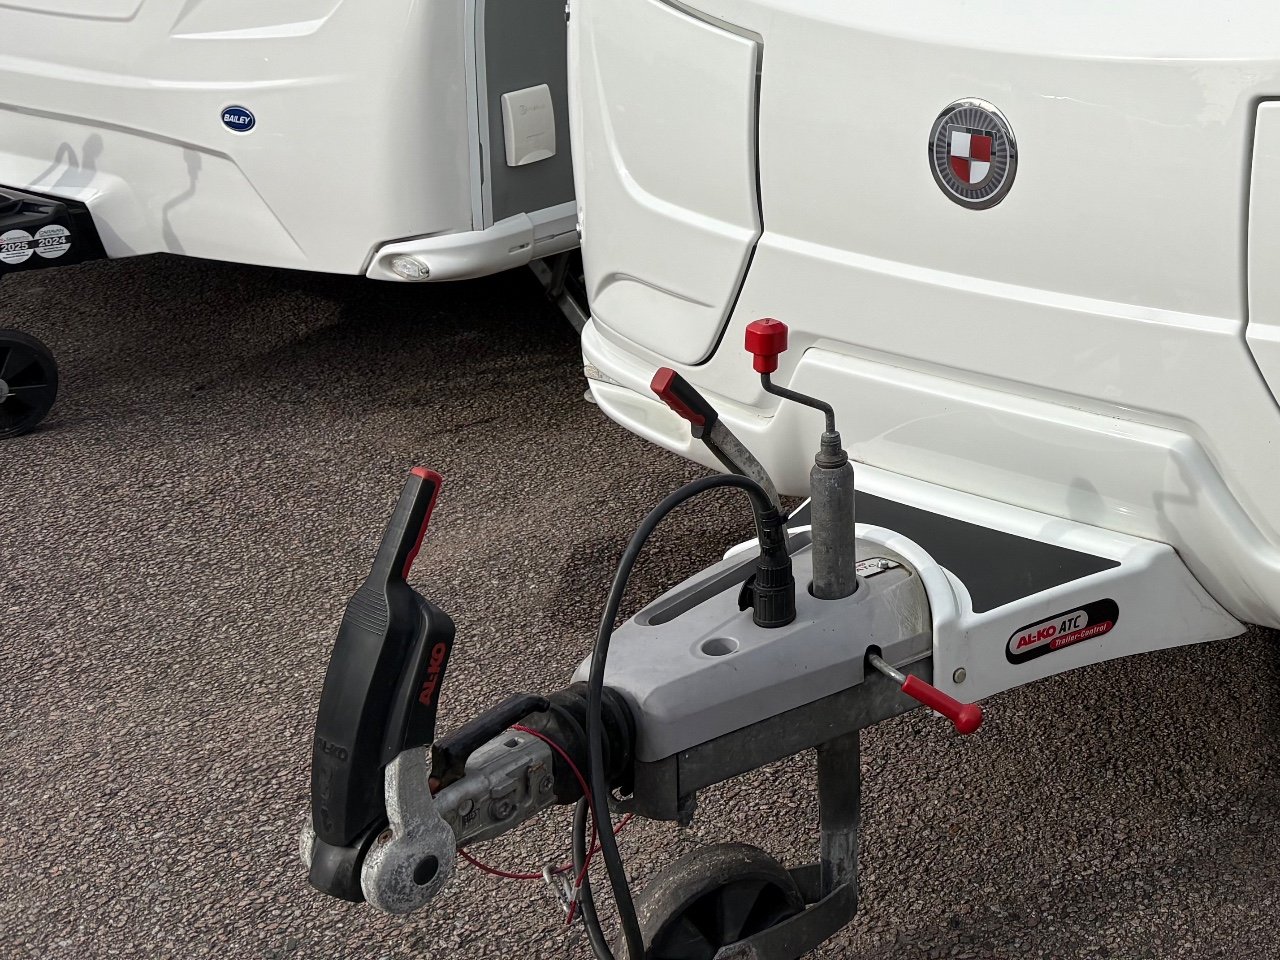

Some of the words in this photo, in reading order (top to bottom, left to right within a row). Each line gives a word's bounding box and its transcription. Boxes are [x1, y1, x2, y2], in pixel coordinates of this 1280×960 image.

[223, 113, 251, 125] BAILEY
[1, 241, 29, 252] 2025
[38, 236, 67, 247] 2024
[1016, 624, 1057, 650] AL-KO
[1058, 614, 1082, 635] ATC
[1055, 623, 1107, 648] Trailer-Control
[418, 640, 447, 707] AL-KO
